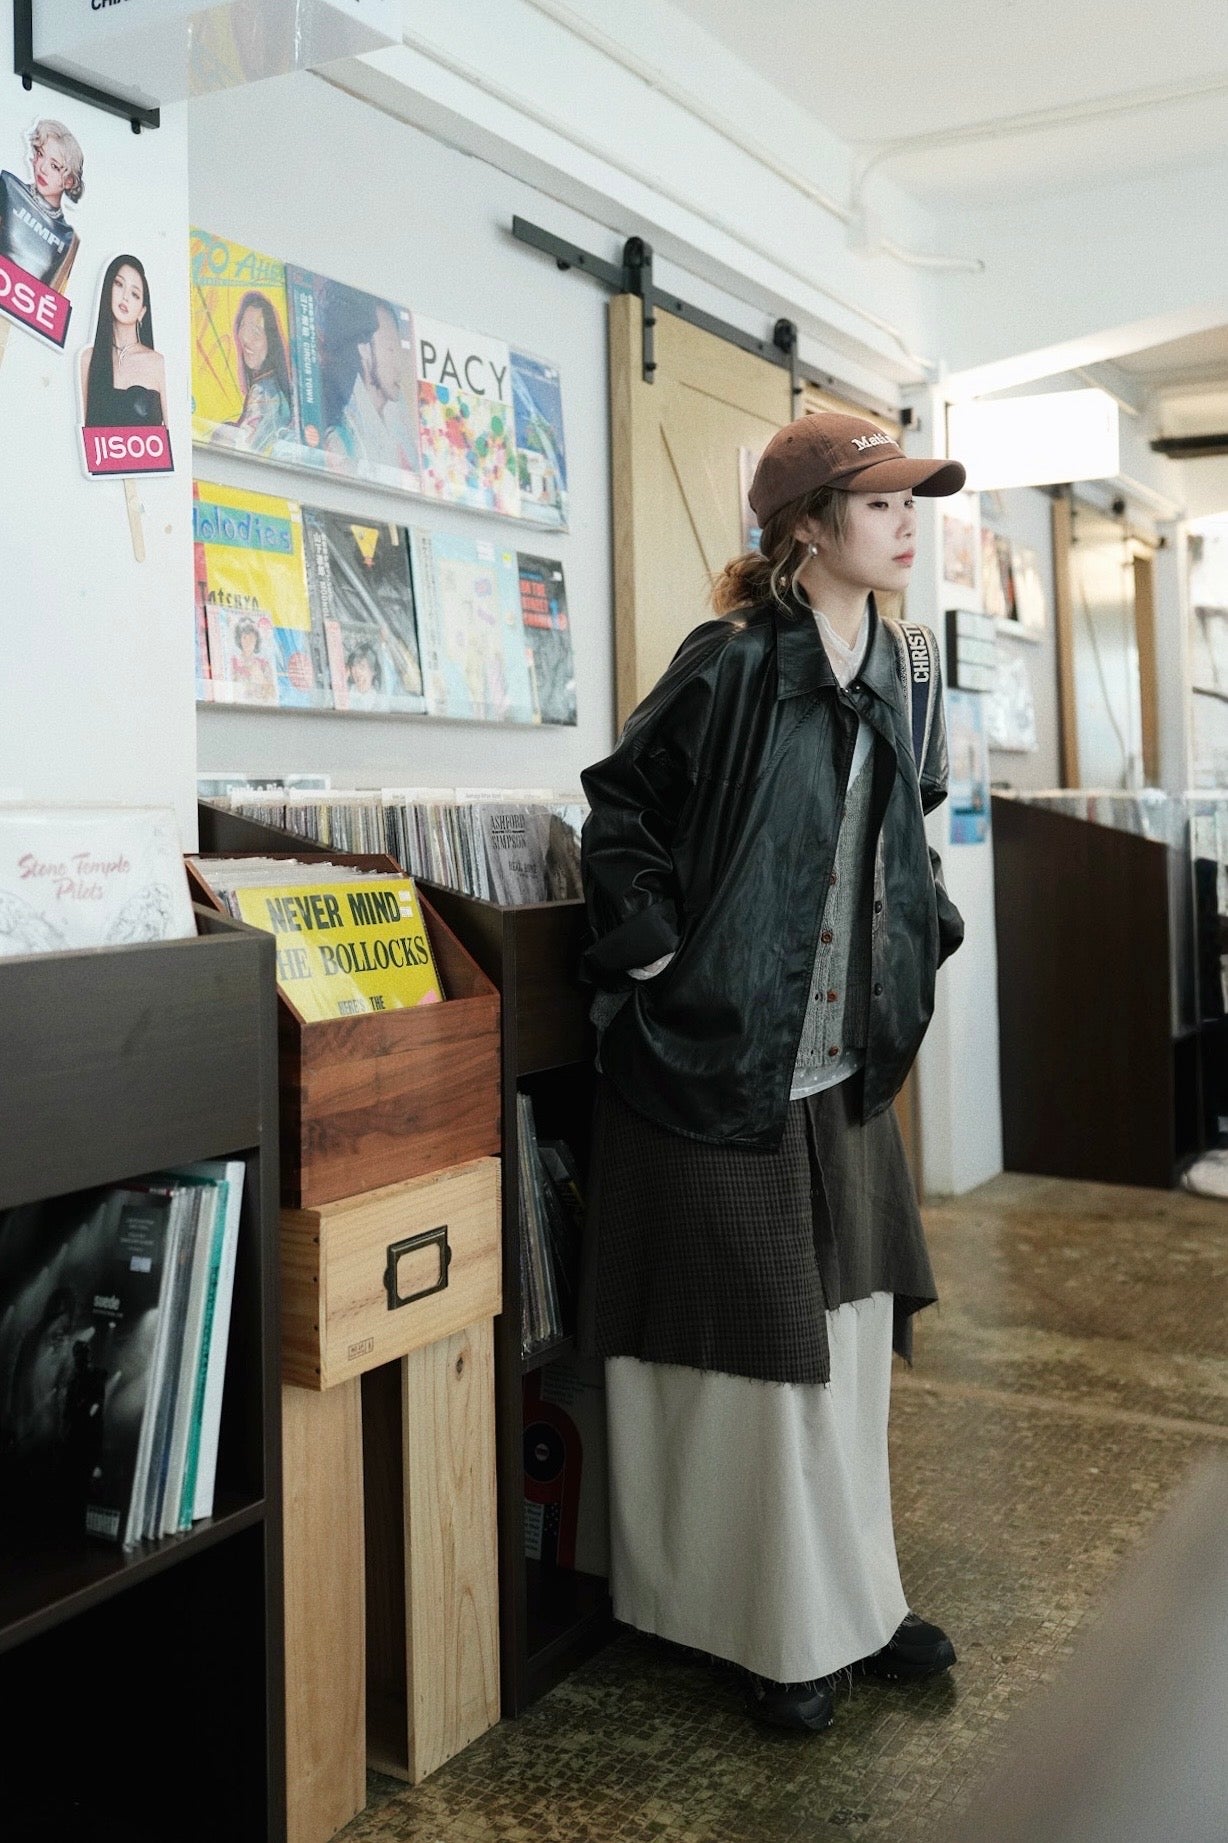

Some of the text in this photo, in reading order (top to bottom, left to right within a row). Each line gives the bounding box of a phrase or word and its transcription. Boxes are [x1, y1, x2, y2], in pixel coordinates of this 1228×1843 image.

[0, 268, 58, 330] OSÉ
[303, 341, 313, 377] CIRCUS
[420, 340, 507, 401] PACY
[306, 377, 314, 404] TOWN
[94, 434, 164, 466] JISOO
[319, 581, 330, 618] MOONGL
[72, 852, 131, 877] Temple
[266, 891, 401, 934] NEVER MIND
[276, 935, 429, 981] HE BOLLOCKS
[369, 995, 386, 1011] THE
